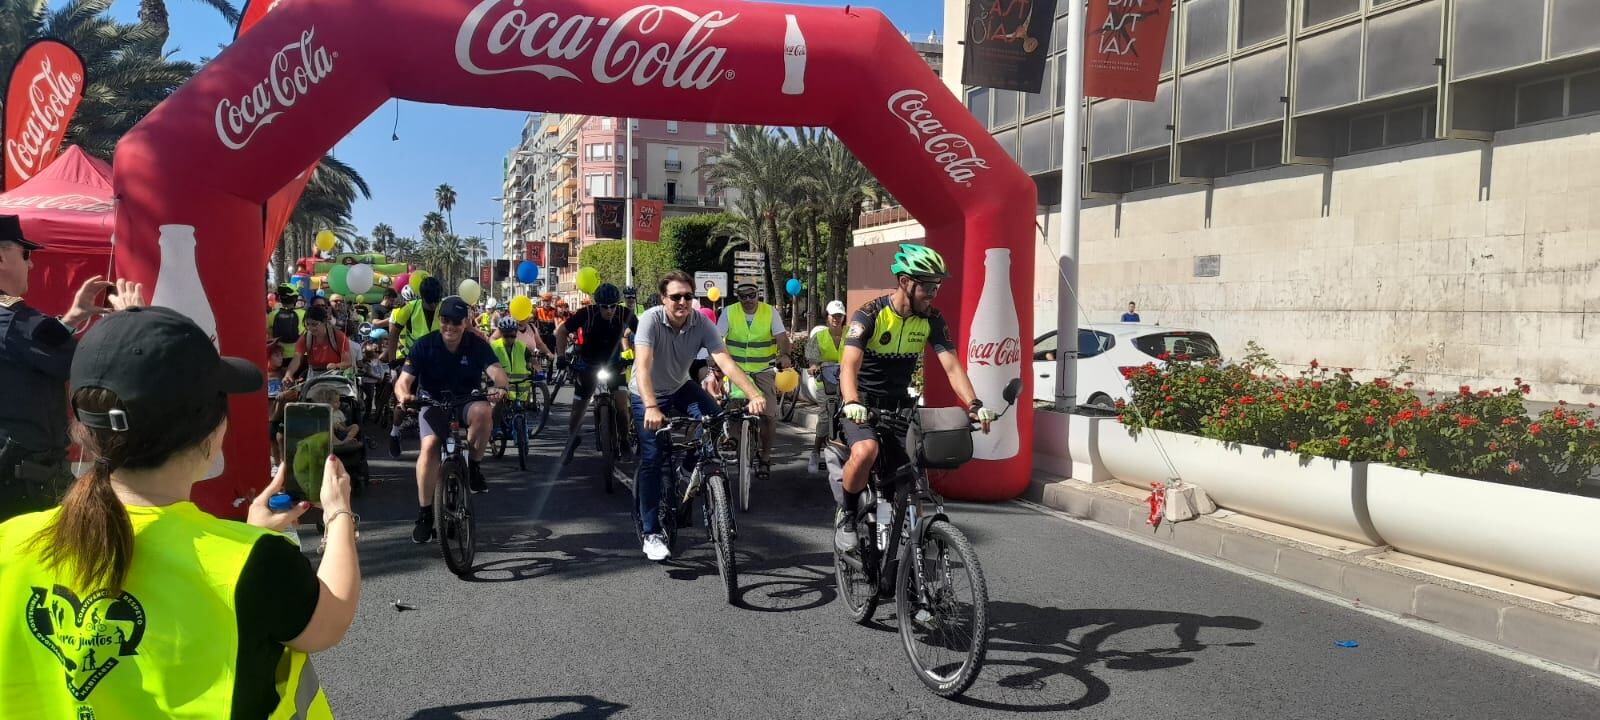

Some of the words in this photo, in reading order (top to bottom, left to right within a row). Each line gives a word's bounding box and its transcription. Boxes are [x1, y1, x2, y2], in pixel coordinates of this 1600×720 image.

[1102, 12, 1141, 32] AST
[455, 0, 739, 90] Coca-Cola
[215, 25, 333, 150] Coca-Cola
[7, 55, 76, 181] Coca-Cola
[888, 89, 992, 184] Coca-Cola
[969, 337, 1020, 366] Coca-Cola
[916, 547, 925, 590] POLICIA
[75, 632, 112, 651] juntos
[80, 661, 115, 696] HABITABLE
